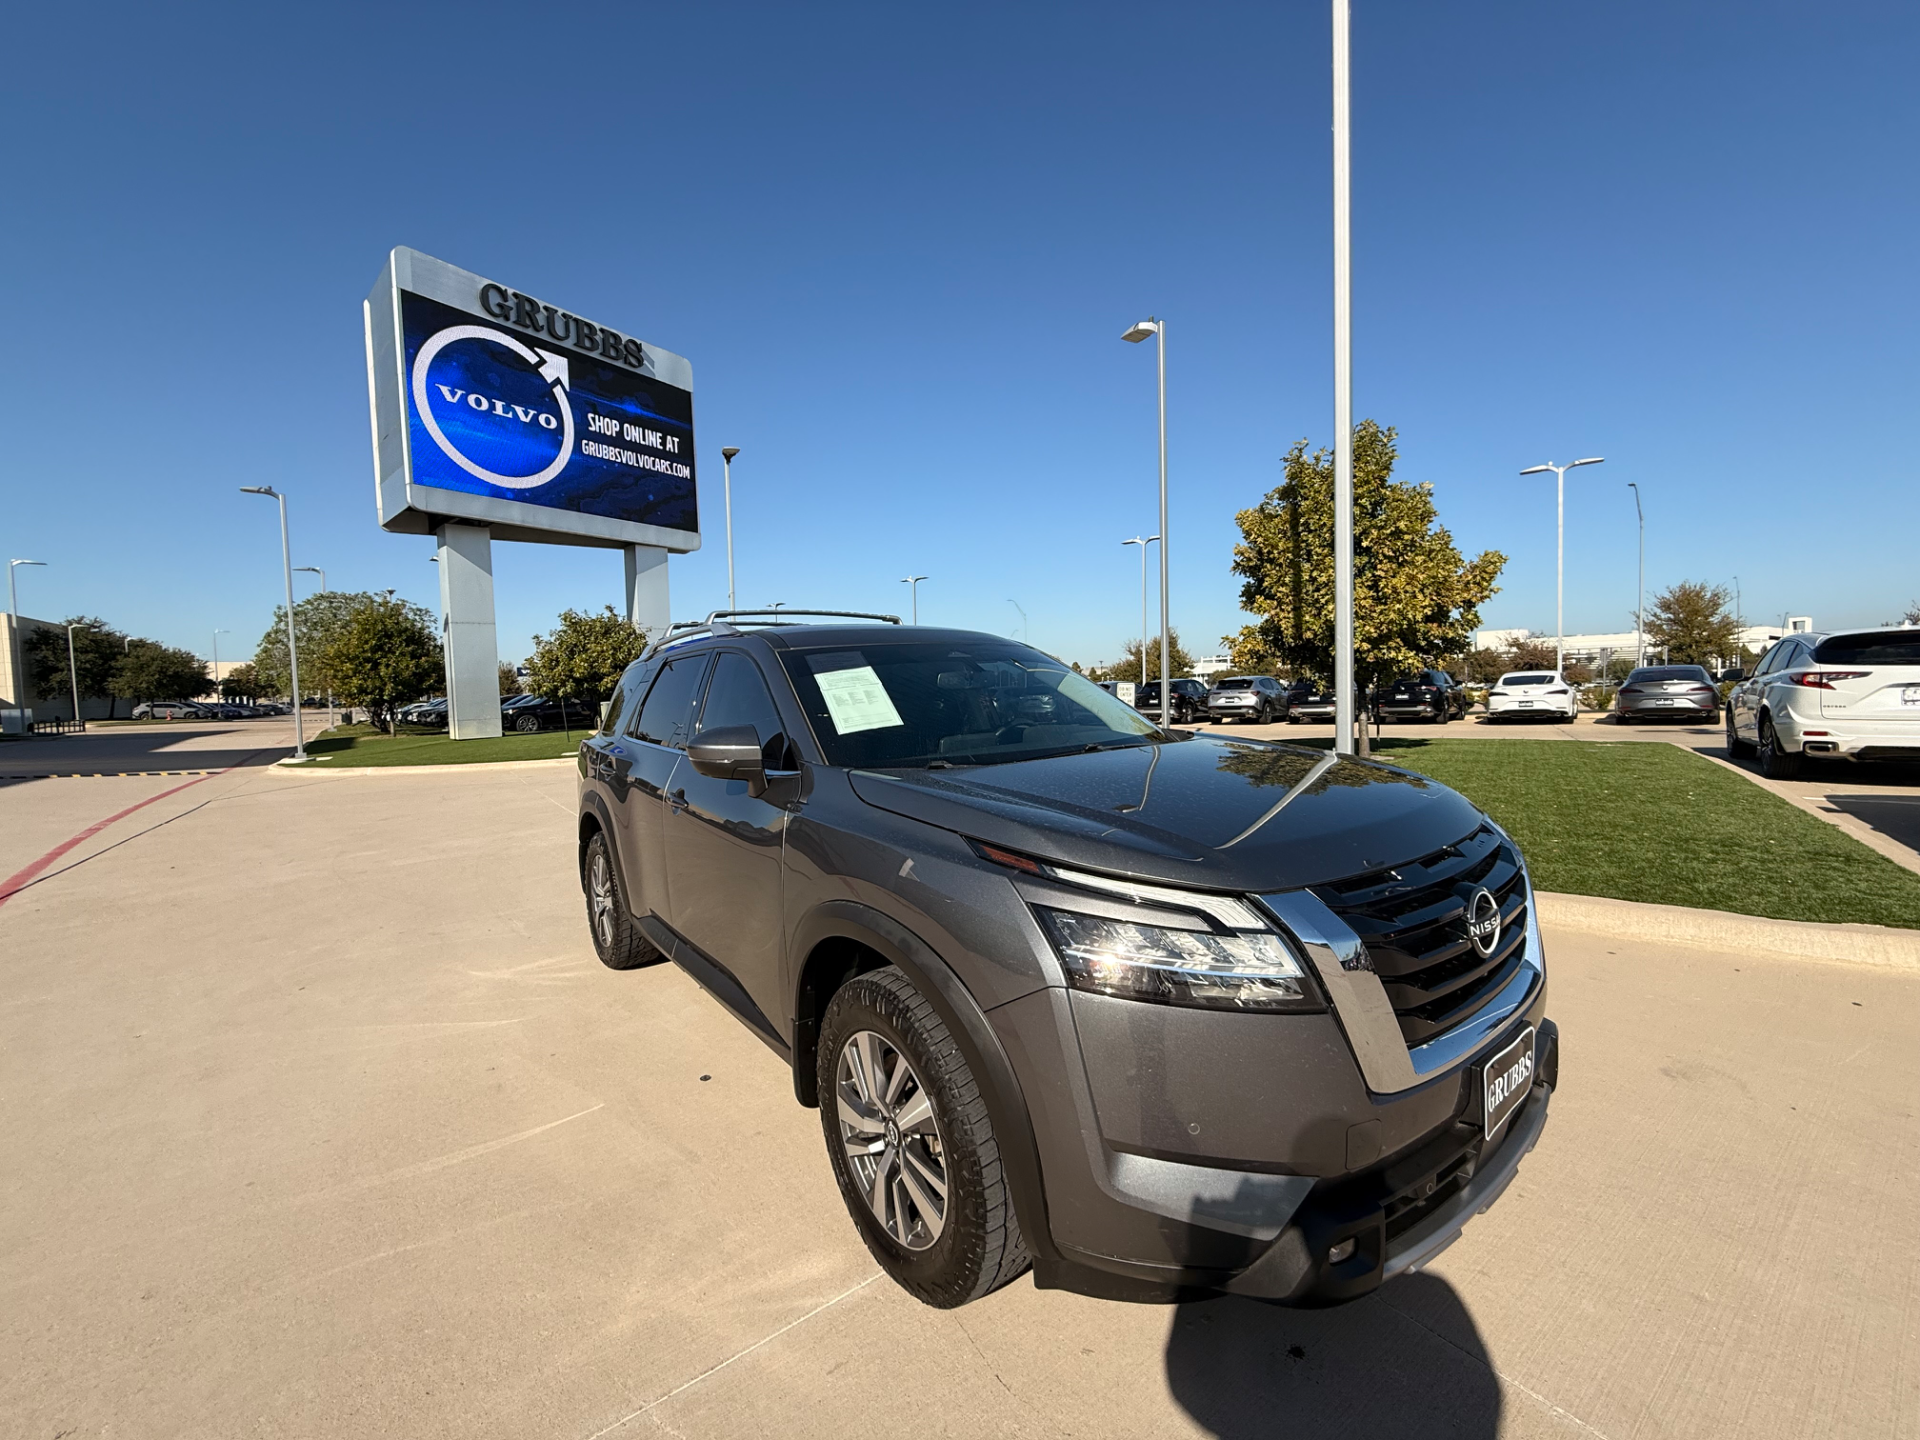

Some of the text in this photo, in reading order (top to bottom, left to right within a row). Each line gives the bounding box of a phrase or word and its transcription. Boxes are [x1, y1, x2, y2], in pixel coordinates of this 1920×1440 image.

[478, 283, 645, 369] GRUBBS
[434, 383, 558, 430] VOLVO
[587, 412, 680, 454] SHOP ONLINE AT
[581, 439, 691, 480] GRUBBSVOLVOCARS.COM
[1488, 1050, 1532, 1113] GRUBBS
